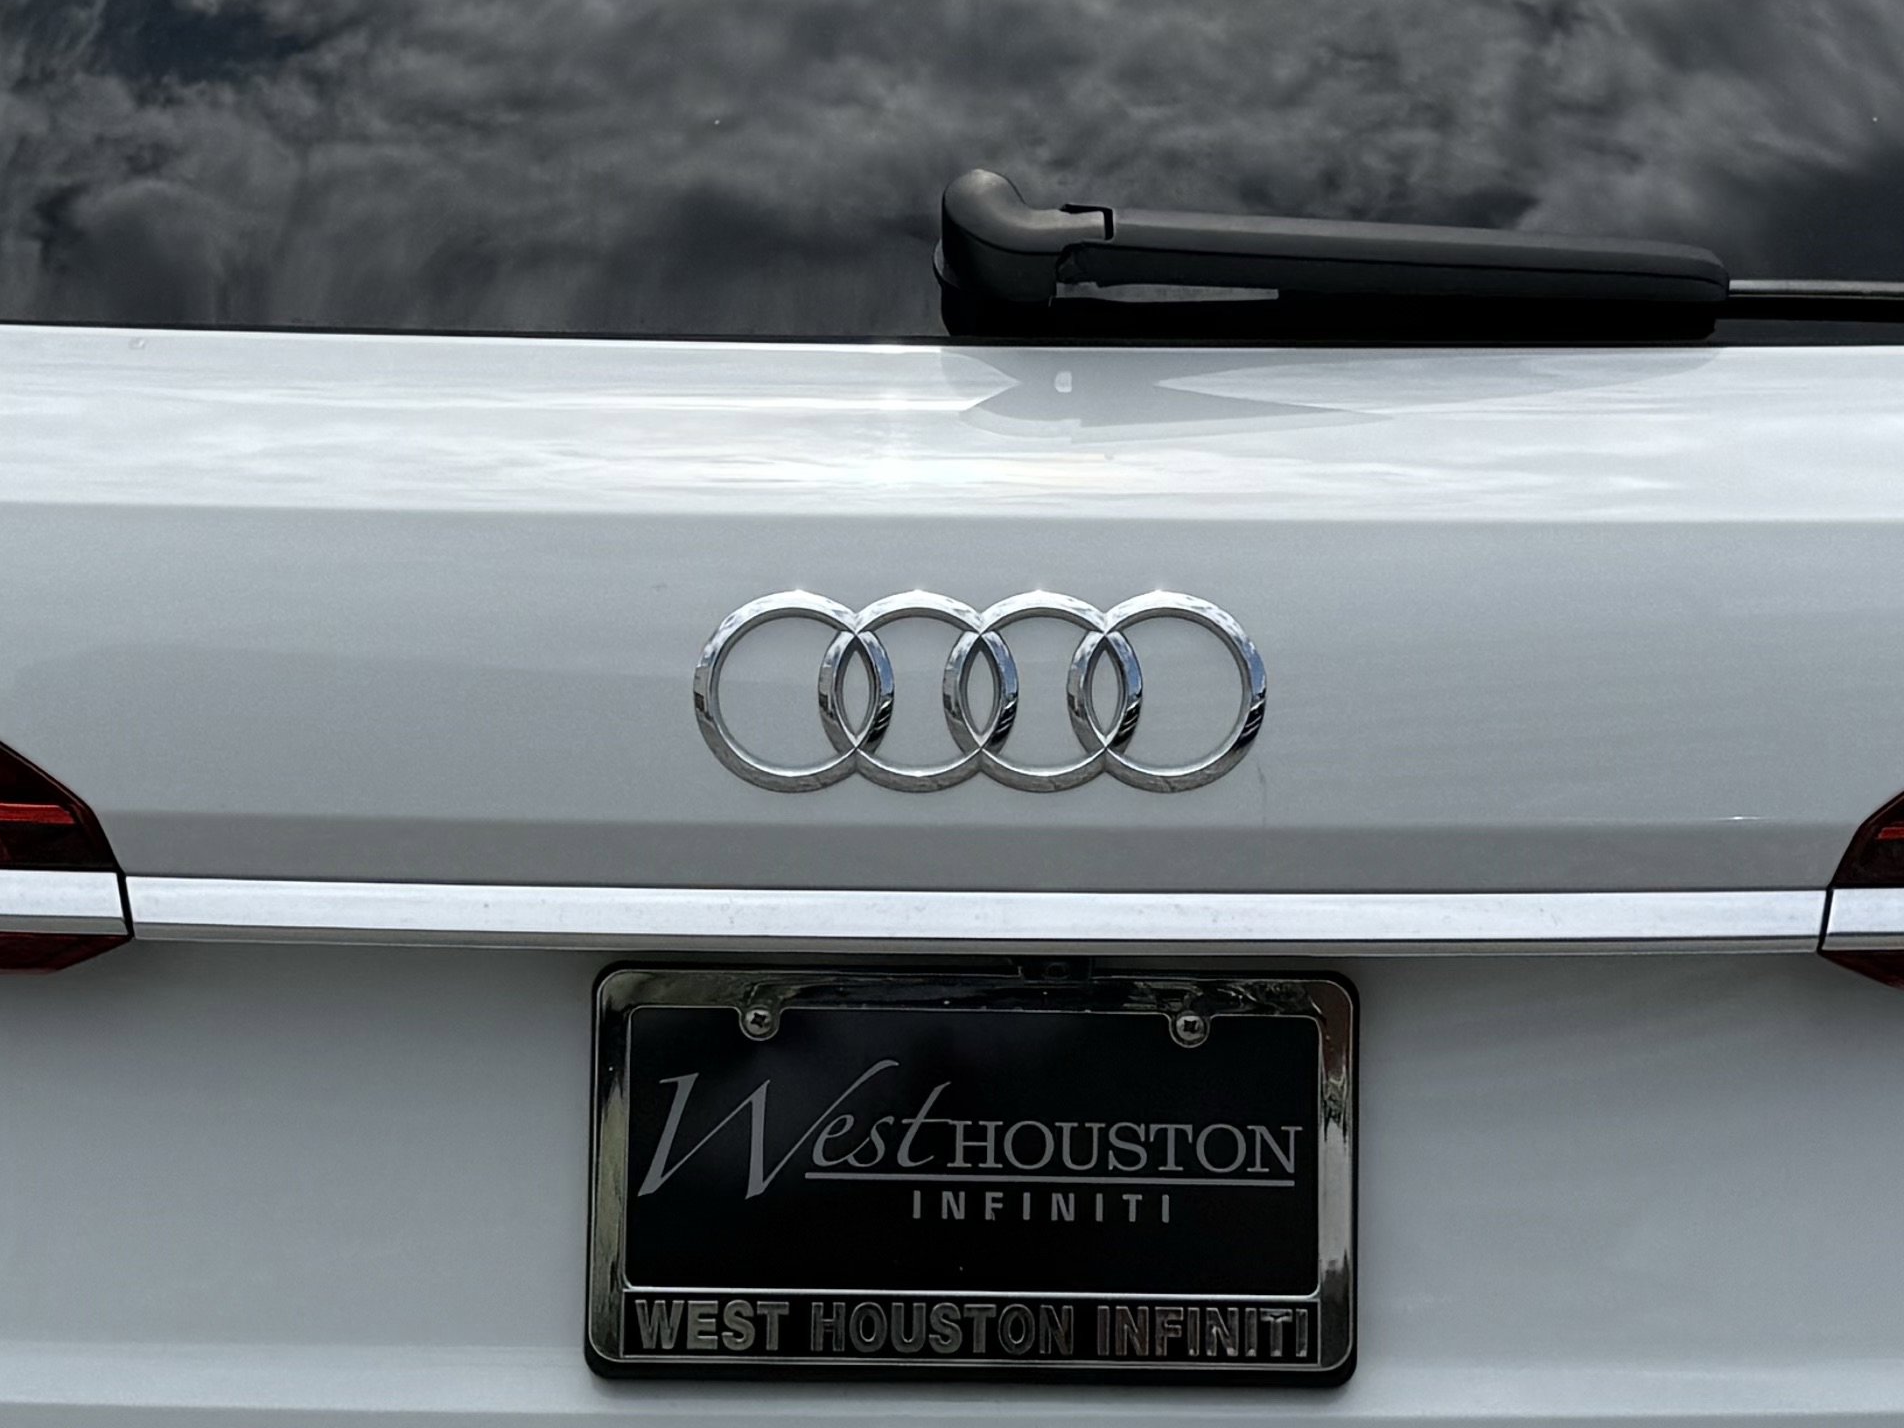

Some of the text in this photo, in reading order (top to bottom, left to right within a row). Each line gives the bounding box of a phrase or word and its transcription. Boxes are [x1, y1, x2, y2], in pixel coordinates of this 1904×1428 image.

[637, 1059, 1305, 1201] West HOUSTON
[911, 1189, 1173, 1223] INFINITI
[635, 1299, 1309, 1359] WEST HOUSTON INFINITI
